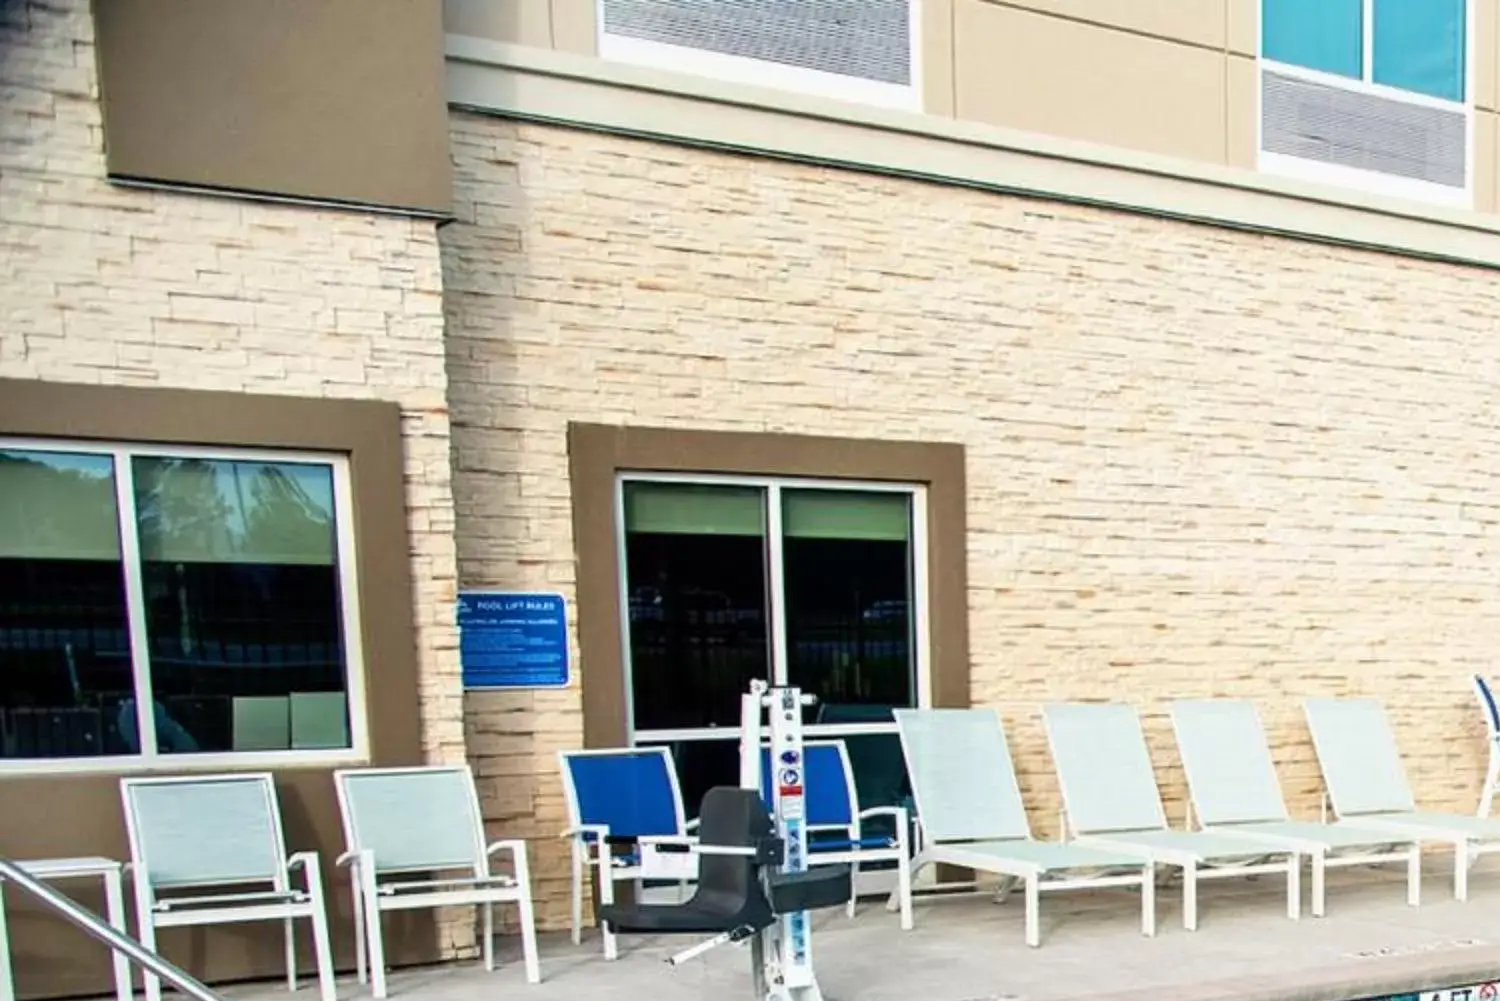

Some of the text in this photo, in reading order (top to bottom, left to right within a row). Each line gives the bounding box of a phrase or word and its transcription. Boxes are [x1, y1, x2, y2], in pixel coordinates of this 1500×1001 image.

[477, 599, 556, 611] POOL LIFT RULES
